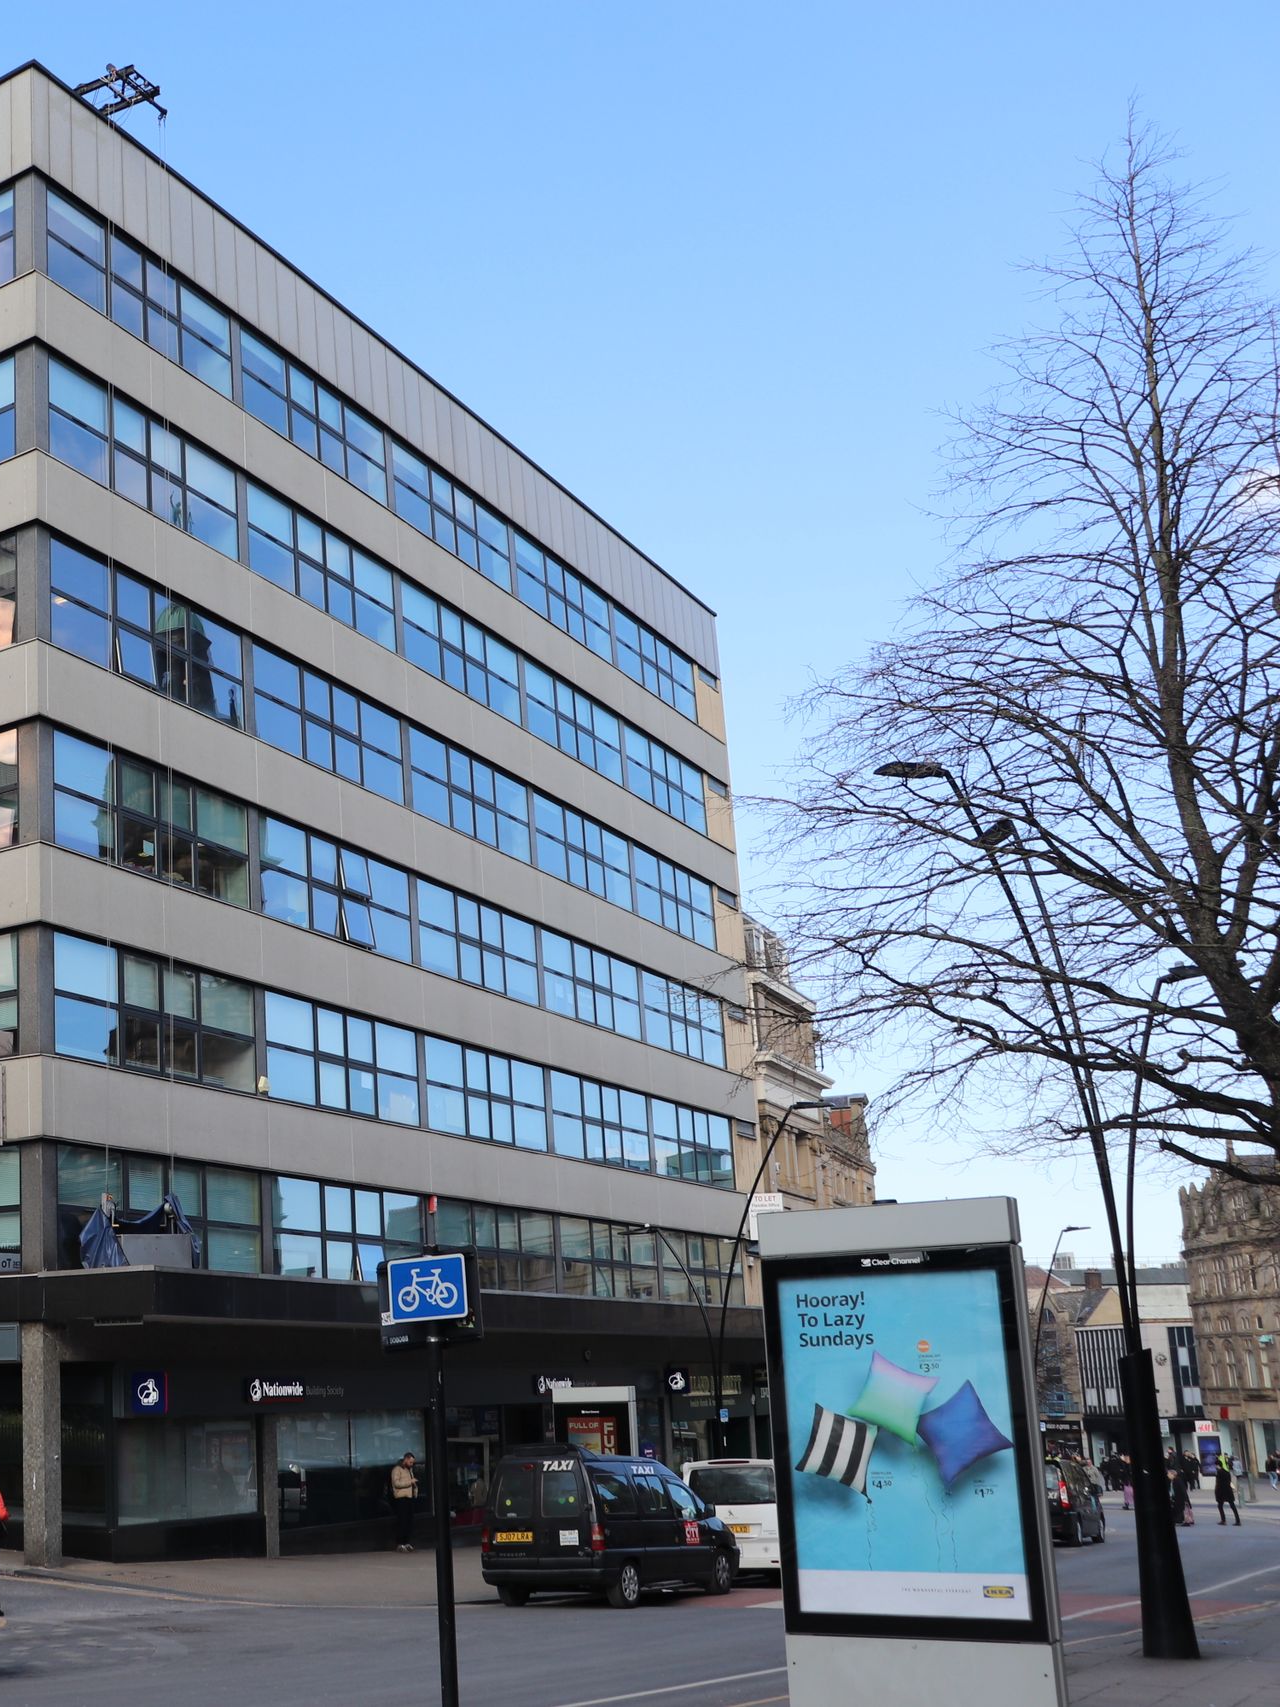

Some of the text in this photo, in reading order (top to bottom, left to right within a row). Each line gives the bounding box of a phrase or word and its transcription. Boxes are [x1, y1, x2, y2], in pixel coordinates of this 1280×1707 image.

[796, 1291, 865, 1310] Hooray!
[798, 1312, 866, 1330] To Lazy
[799, 1331, 875, 1350] Sundays
[262, 1381, 304, 1397] Nationwide
[543, 1460, 575, 1472] TAXI
[631, 1465, 655, 1475] TAXI
